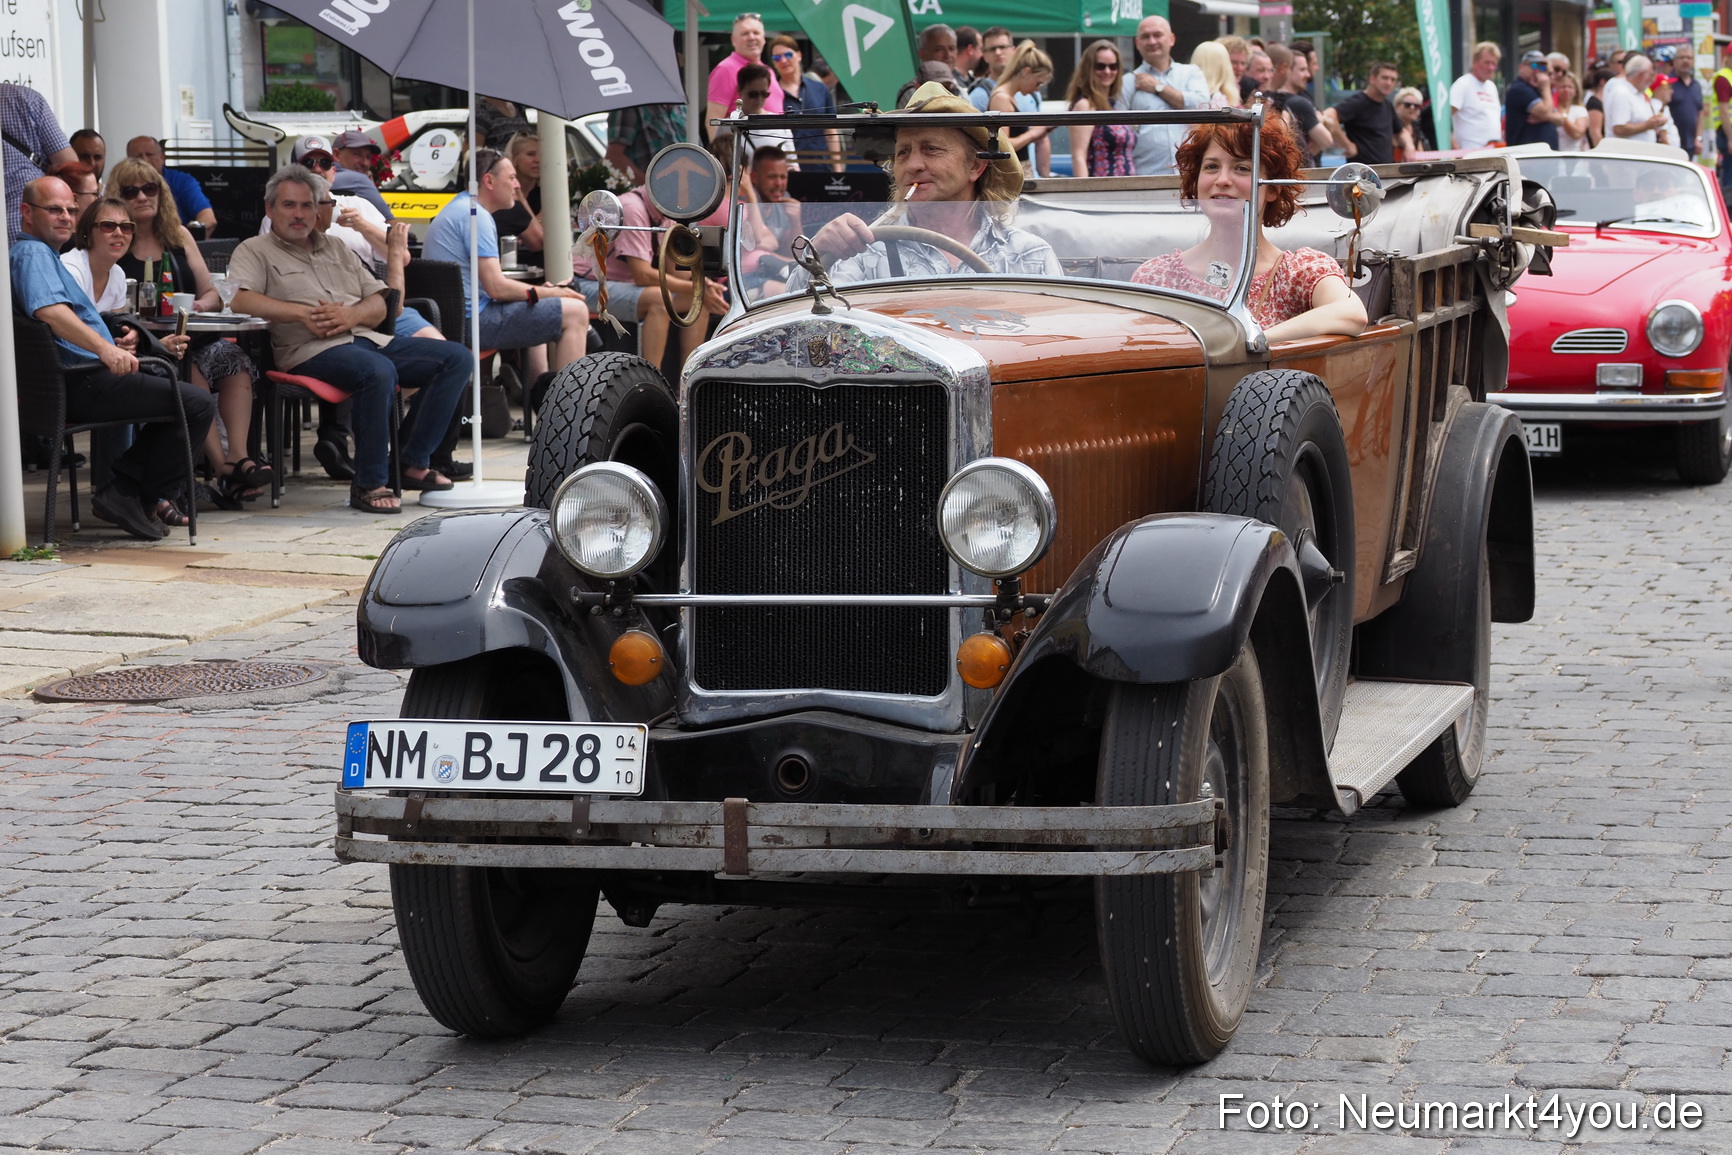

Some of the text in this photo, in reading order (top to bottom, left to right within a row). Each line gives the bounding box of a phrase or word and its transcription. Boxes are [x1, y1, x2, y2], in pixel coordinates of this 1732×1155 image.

[0, 30, 45, 58] ufsen
[431, 149, 440, 160] 6
[388, 202, 439, 210] ttro
[694, 420, 877, 527] Praga
[616, 735, 636, 749] 04
[350, 763, 359, 777] D
[366, 730, 429, 779] NM
[462, 731, 529, 782] BJ
[539, 733, 601, 784] 28
[615, 770, 634, 784] 10
